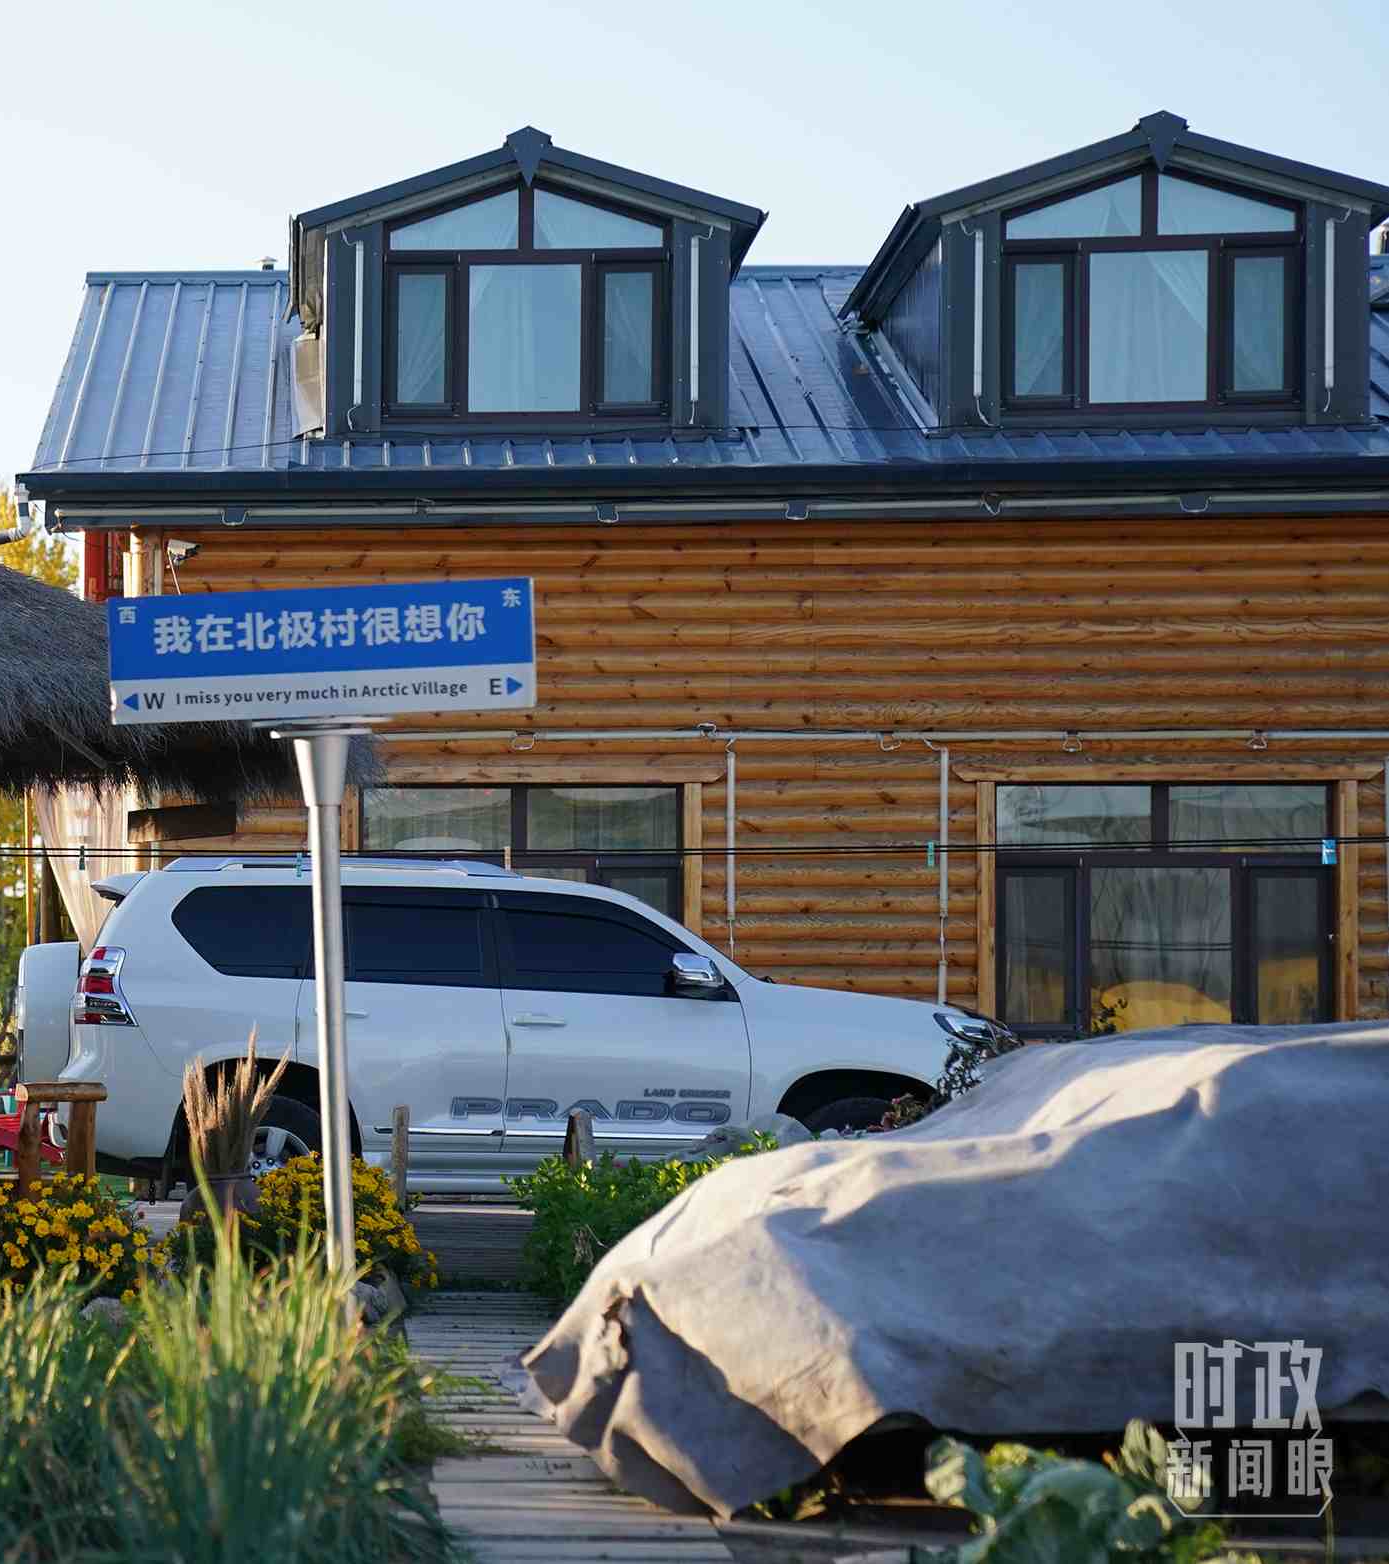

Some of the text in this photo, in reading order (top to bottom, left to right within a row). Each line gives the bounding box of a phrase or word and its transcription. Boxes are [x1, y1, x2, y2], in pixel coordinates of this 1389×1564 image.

[501, 587, 522, 608] 东
[117, 606, 138, 625] 西
[153, 602, 487, 655] 我在北极村很想你
[176, 681, 468, 706] I miss you very much in Arctic Village
[490, 678, 502, 696] E
[143, 692, 165, 710] W
[643, 1088, 676, 1098] LAND
[450, 1096, 732, 1126] PRADO
